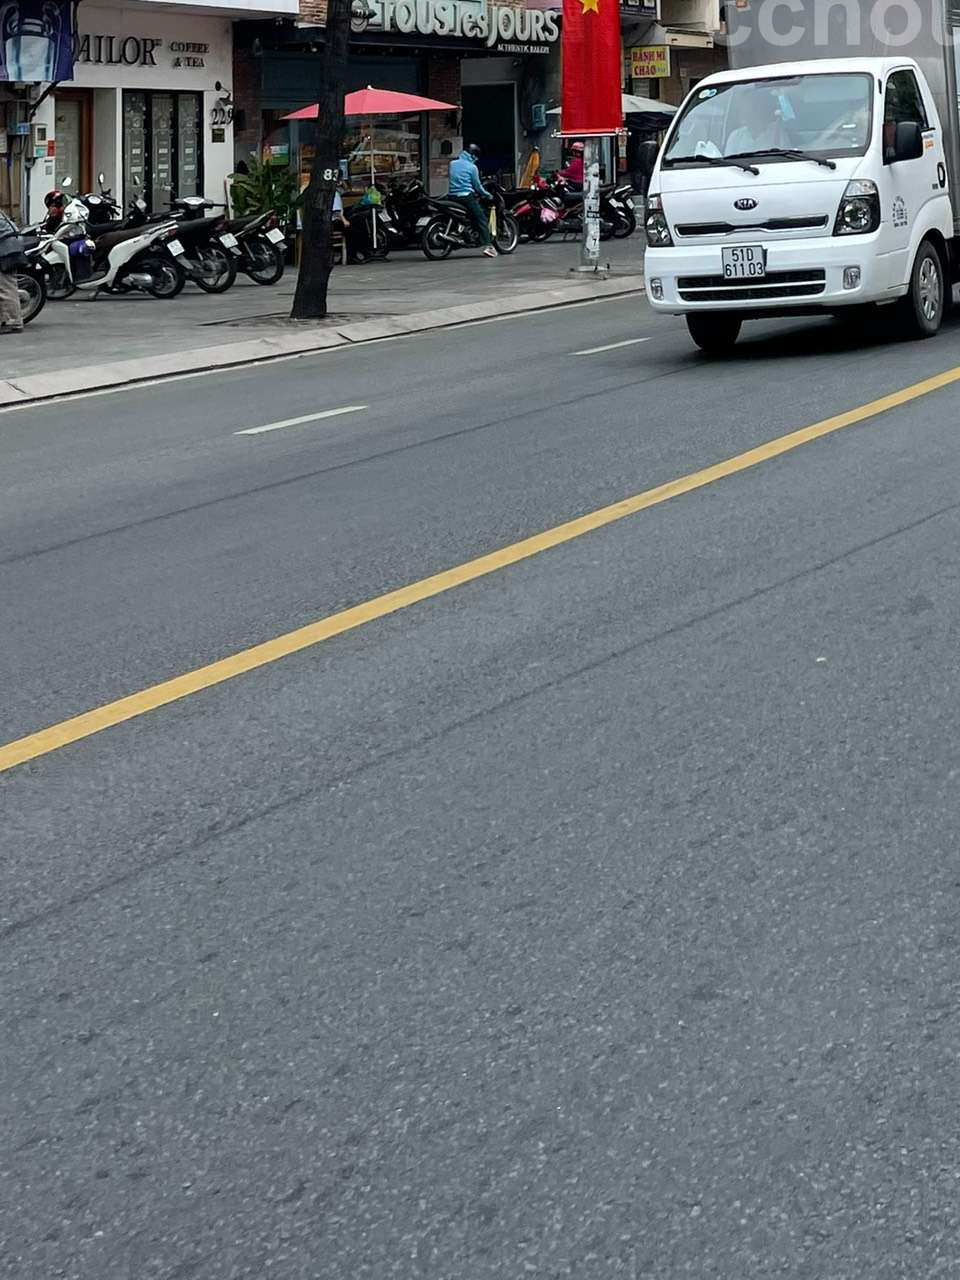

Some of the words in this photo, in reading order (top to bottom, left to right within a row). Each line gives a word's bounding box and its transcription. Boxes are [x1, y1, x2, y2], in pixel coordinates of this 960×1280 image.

[486, 5, 560, 48] JOURS
[76, 33, 158, 66] AILOR
[185, 57, 205, 68] TEA
[736, 199, 754, 208] KIA
[731, 248, 754, 262] 51D
[725, 261, 764, 277] 611.03
